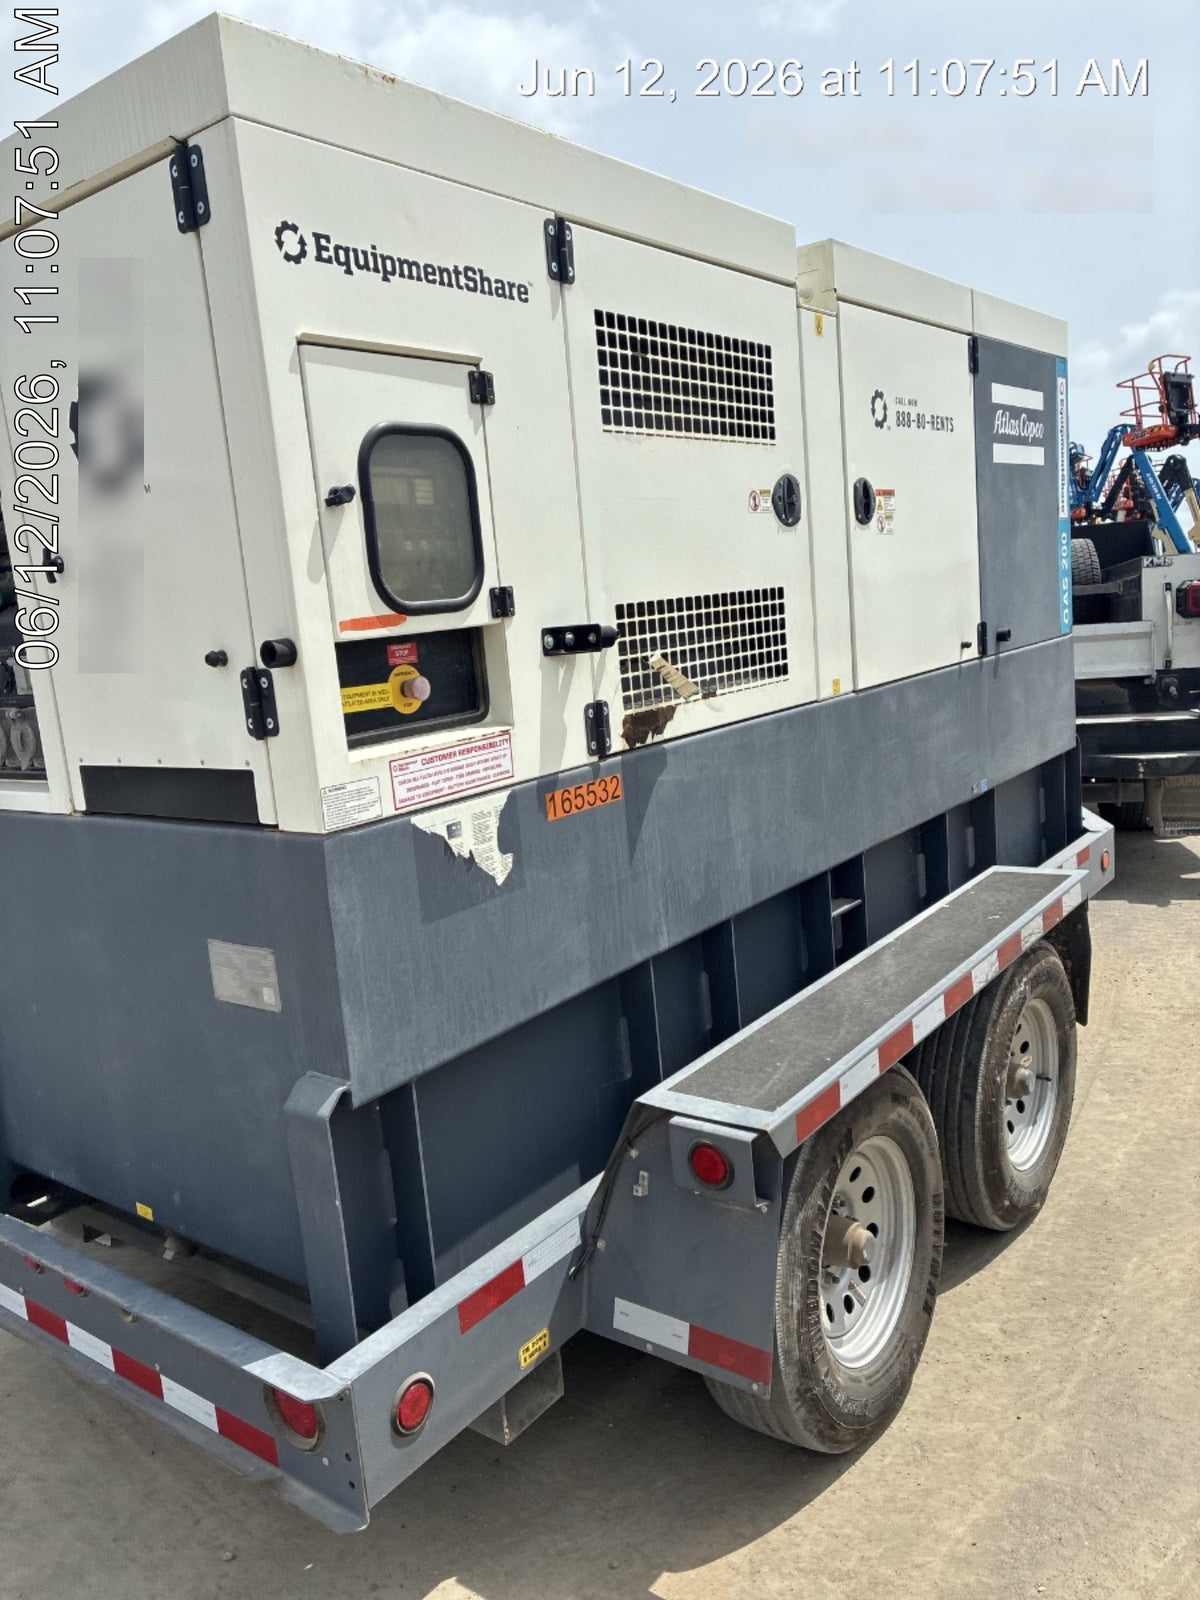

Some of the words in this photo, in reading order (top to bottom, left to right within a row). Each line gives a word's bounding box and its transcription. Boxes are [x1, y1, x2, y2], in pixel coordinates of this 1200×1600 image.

[311, 231, 529, 303] EquipmentShare
[895, 410, 954, 433] 888-80-RENTS
[993, 409, 1019, 436] Atlas
[1019, 413, 1044, 443] Copco
[420, 750, 457, 766] CUSTOMER
[457, 737, 509, 757] RESPONSIBILITY
[548, 775, 621, 818] 165532
